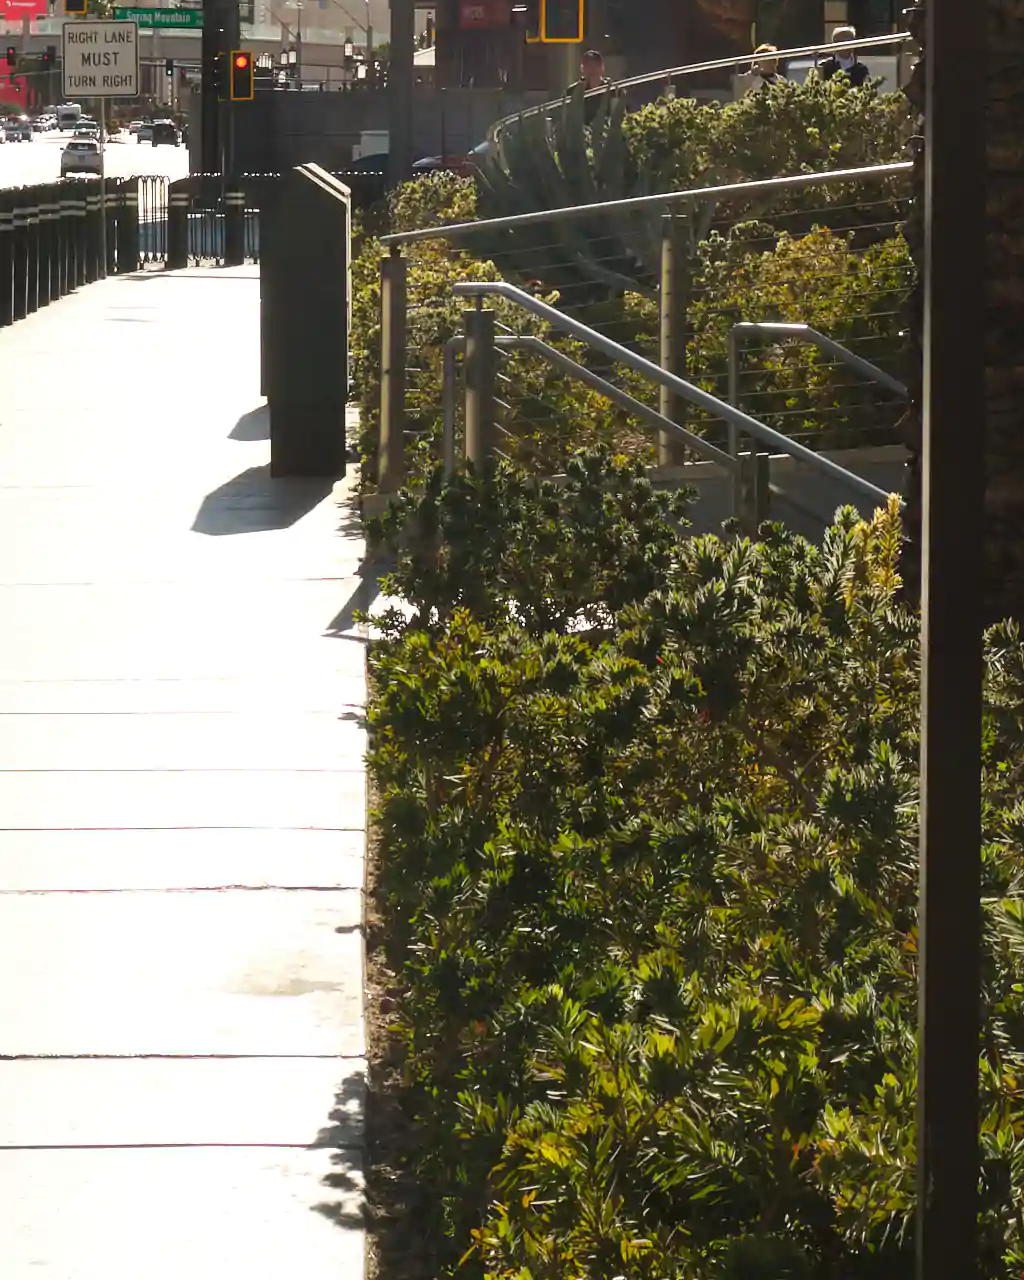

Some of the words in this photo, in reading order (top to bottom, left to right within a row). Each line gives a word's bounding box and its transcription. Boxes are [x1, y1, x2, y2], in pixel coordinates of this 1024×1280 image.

[67, 31, 99, 45] RIGHT
[104, 30, 133, 44] LANE
[81, 51, 120, 67] MUST
[67, 75, 96, 88] TURN
[102, 74, 133, 88] RIGHT
